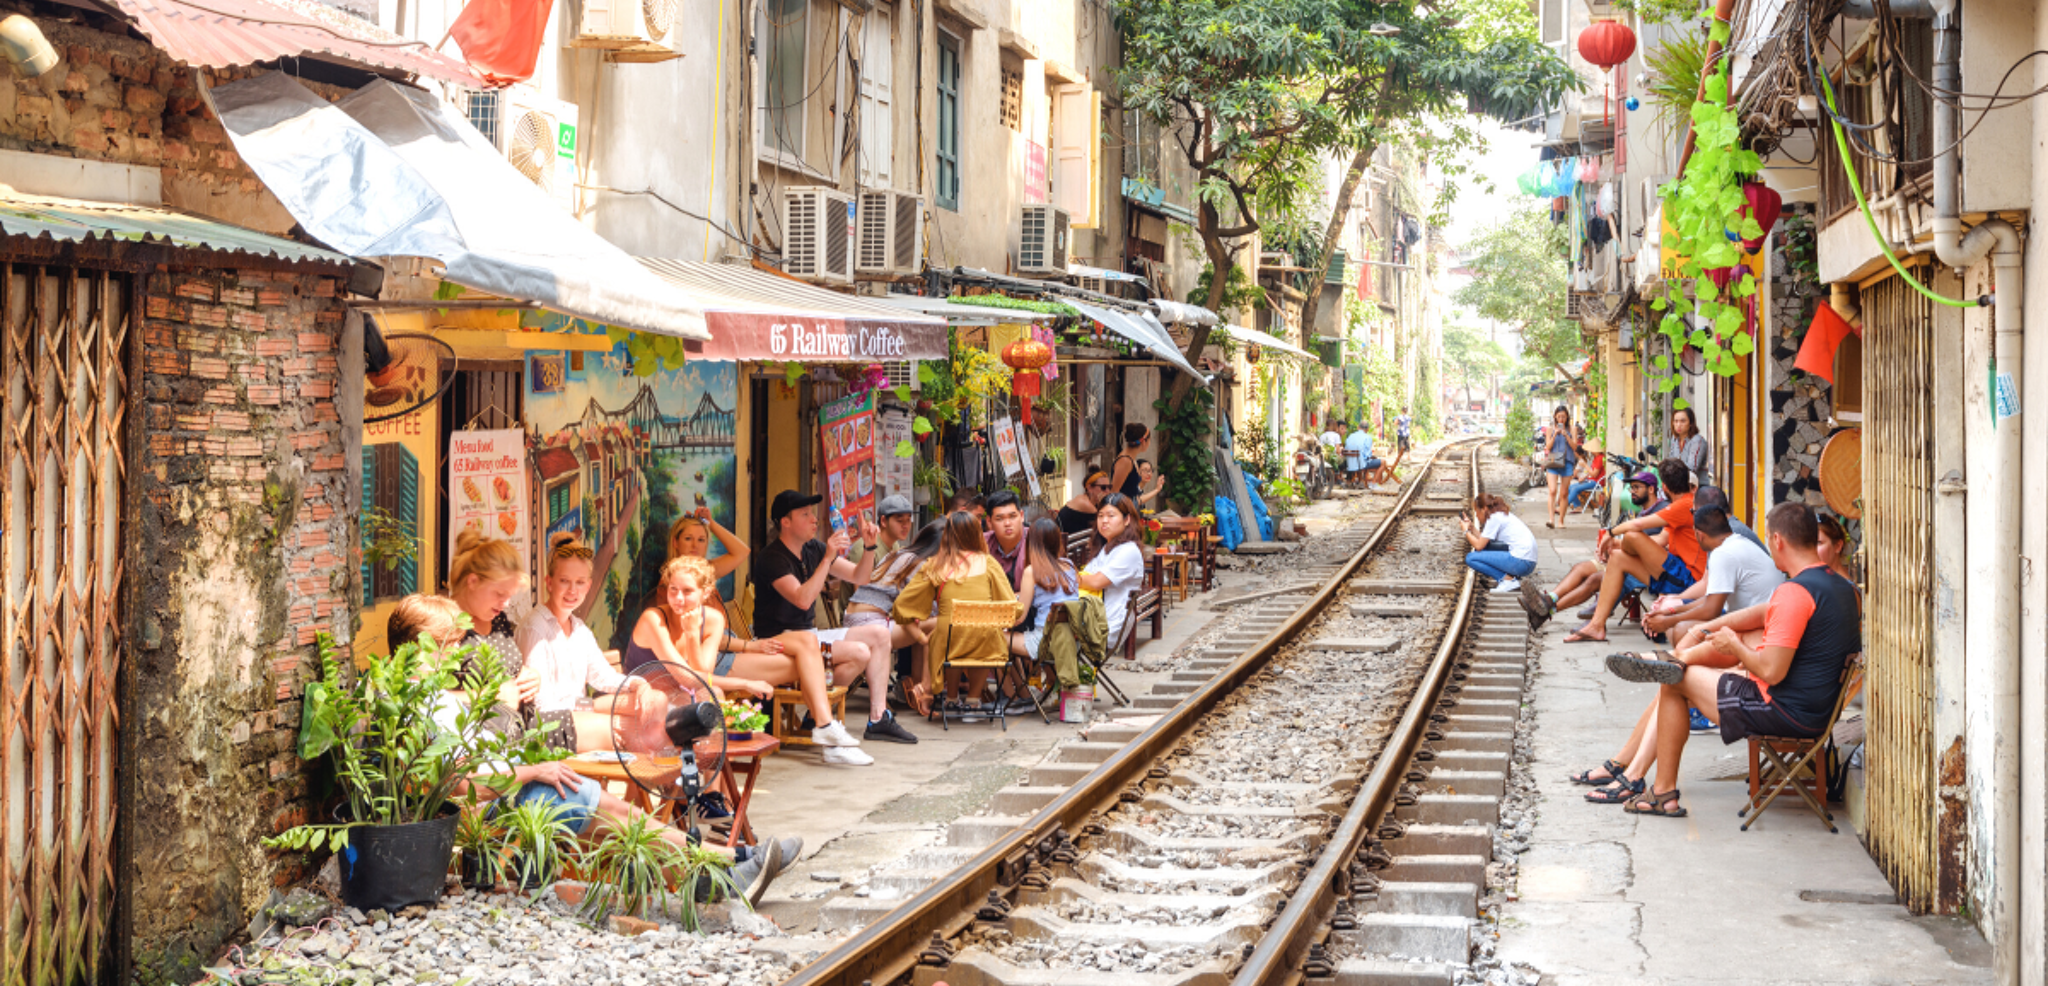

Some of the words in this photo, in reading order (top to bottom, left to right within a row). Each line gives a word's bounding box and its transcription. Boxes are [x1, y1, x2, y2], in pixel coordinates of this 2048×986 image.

[770, 323, 787, 354] 65
[791, 324, 857, 360] Railway
[859, 326, 904, 356] Coffee
[542, 362, 559, 386] 38
[366, 412, 421, 436] COFFEE
[454, 439, 476, 454] Menu
[478, 438, 494, 453] food
[454, 458, 463, 473] 65
[465, 457, 493, 473] Railway
[495, 455, 518, 470] coffee
